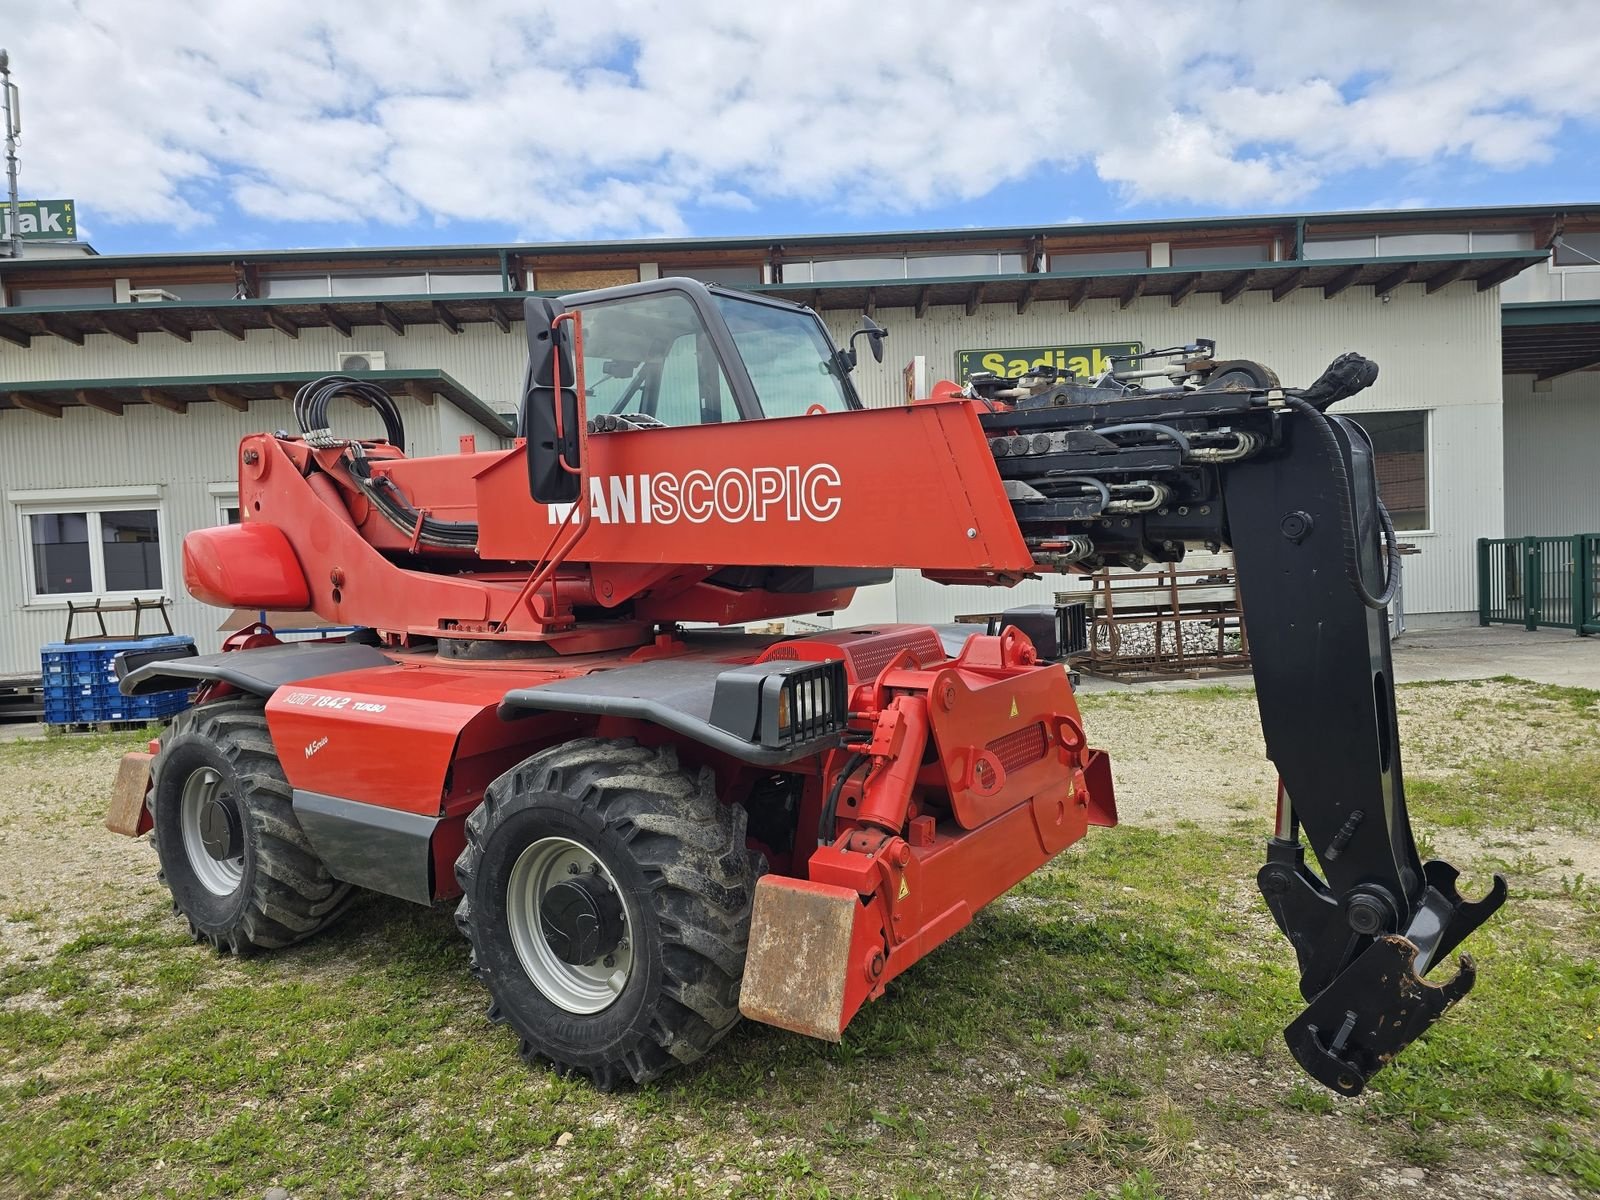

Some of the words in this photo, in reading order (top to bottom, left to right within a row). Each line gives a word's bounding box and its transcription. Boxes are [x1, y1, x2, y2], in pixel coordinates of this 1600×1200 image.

[0, 207, 63, 240] jak
[311, 695, 351, 709] 1842
[352, 702, 387, 713] TURBO
